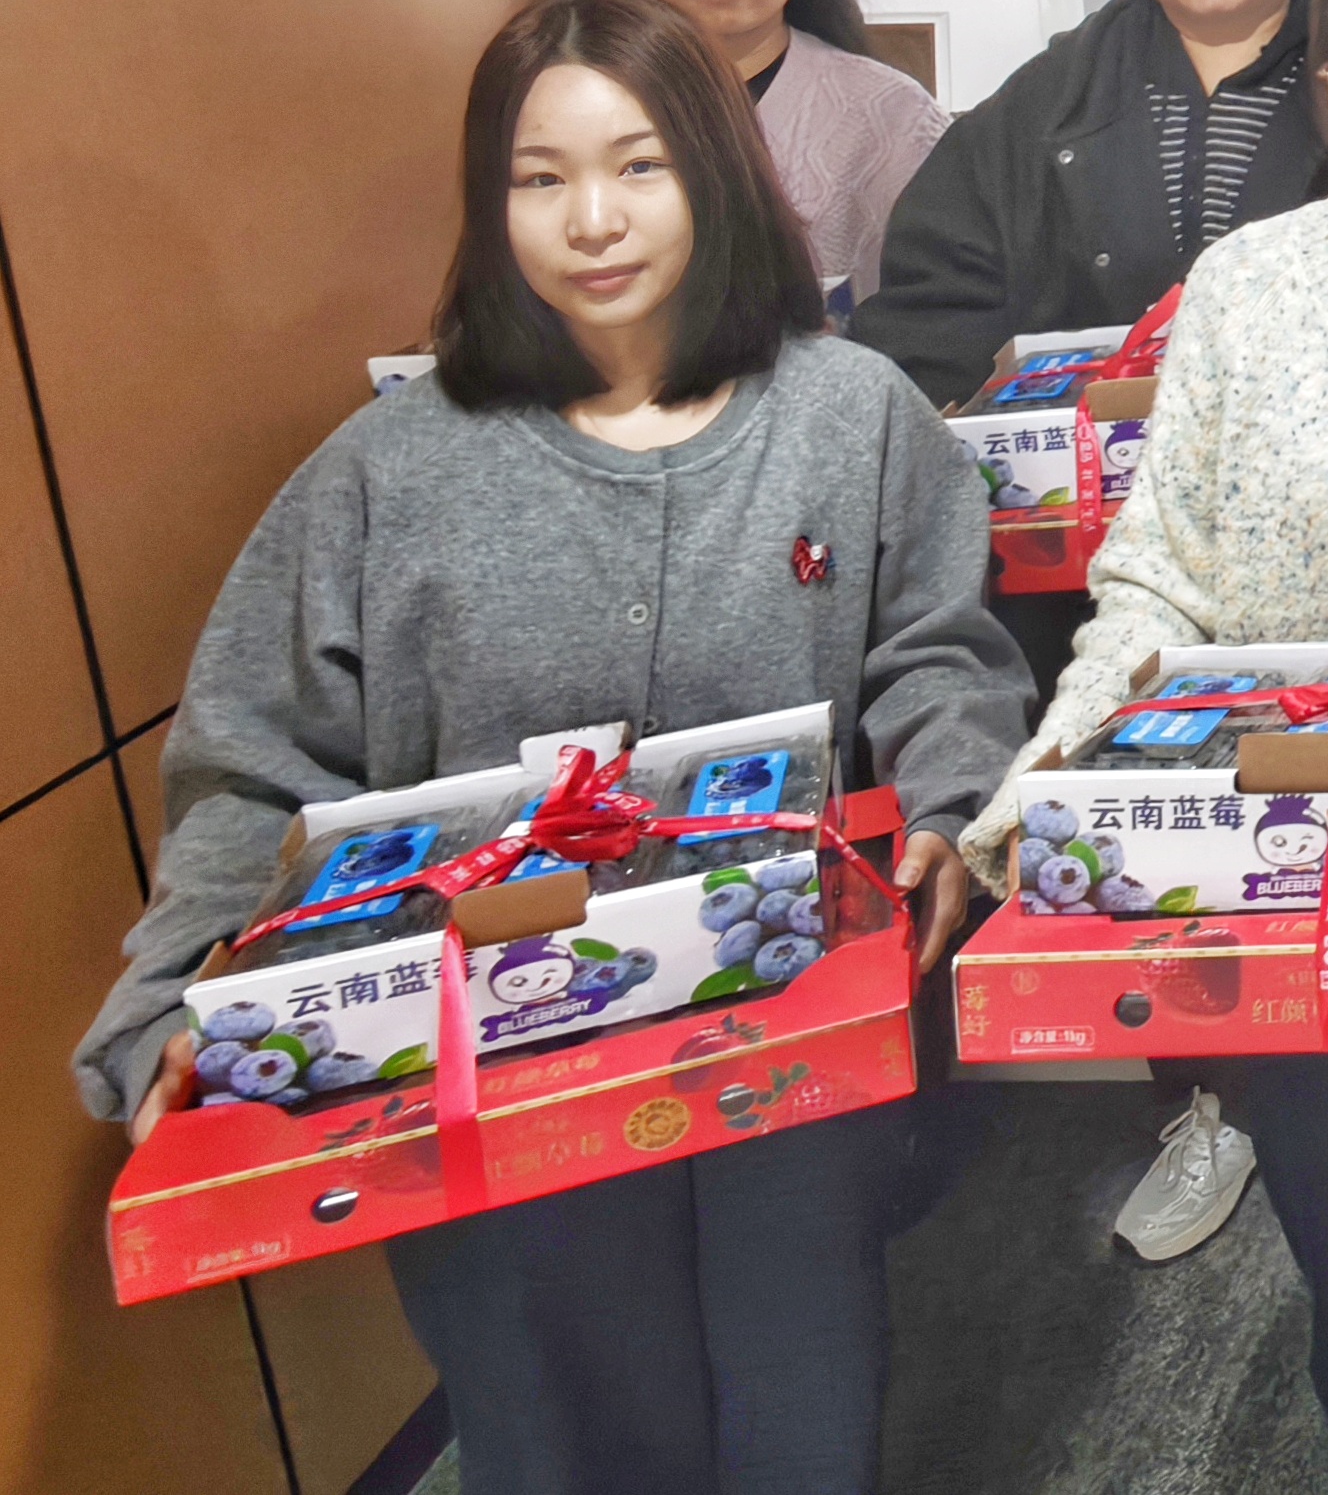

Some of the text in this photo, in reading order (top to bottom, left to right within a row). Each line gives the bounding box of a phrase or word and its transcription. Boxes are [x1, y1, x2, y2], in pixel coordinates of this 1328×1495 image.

[1088, 793, 1247, 832] 云南蓝莓
[1256, 878, 1324, 897] BLUEBER
